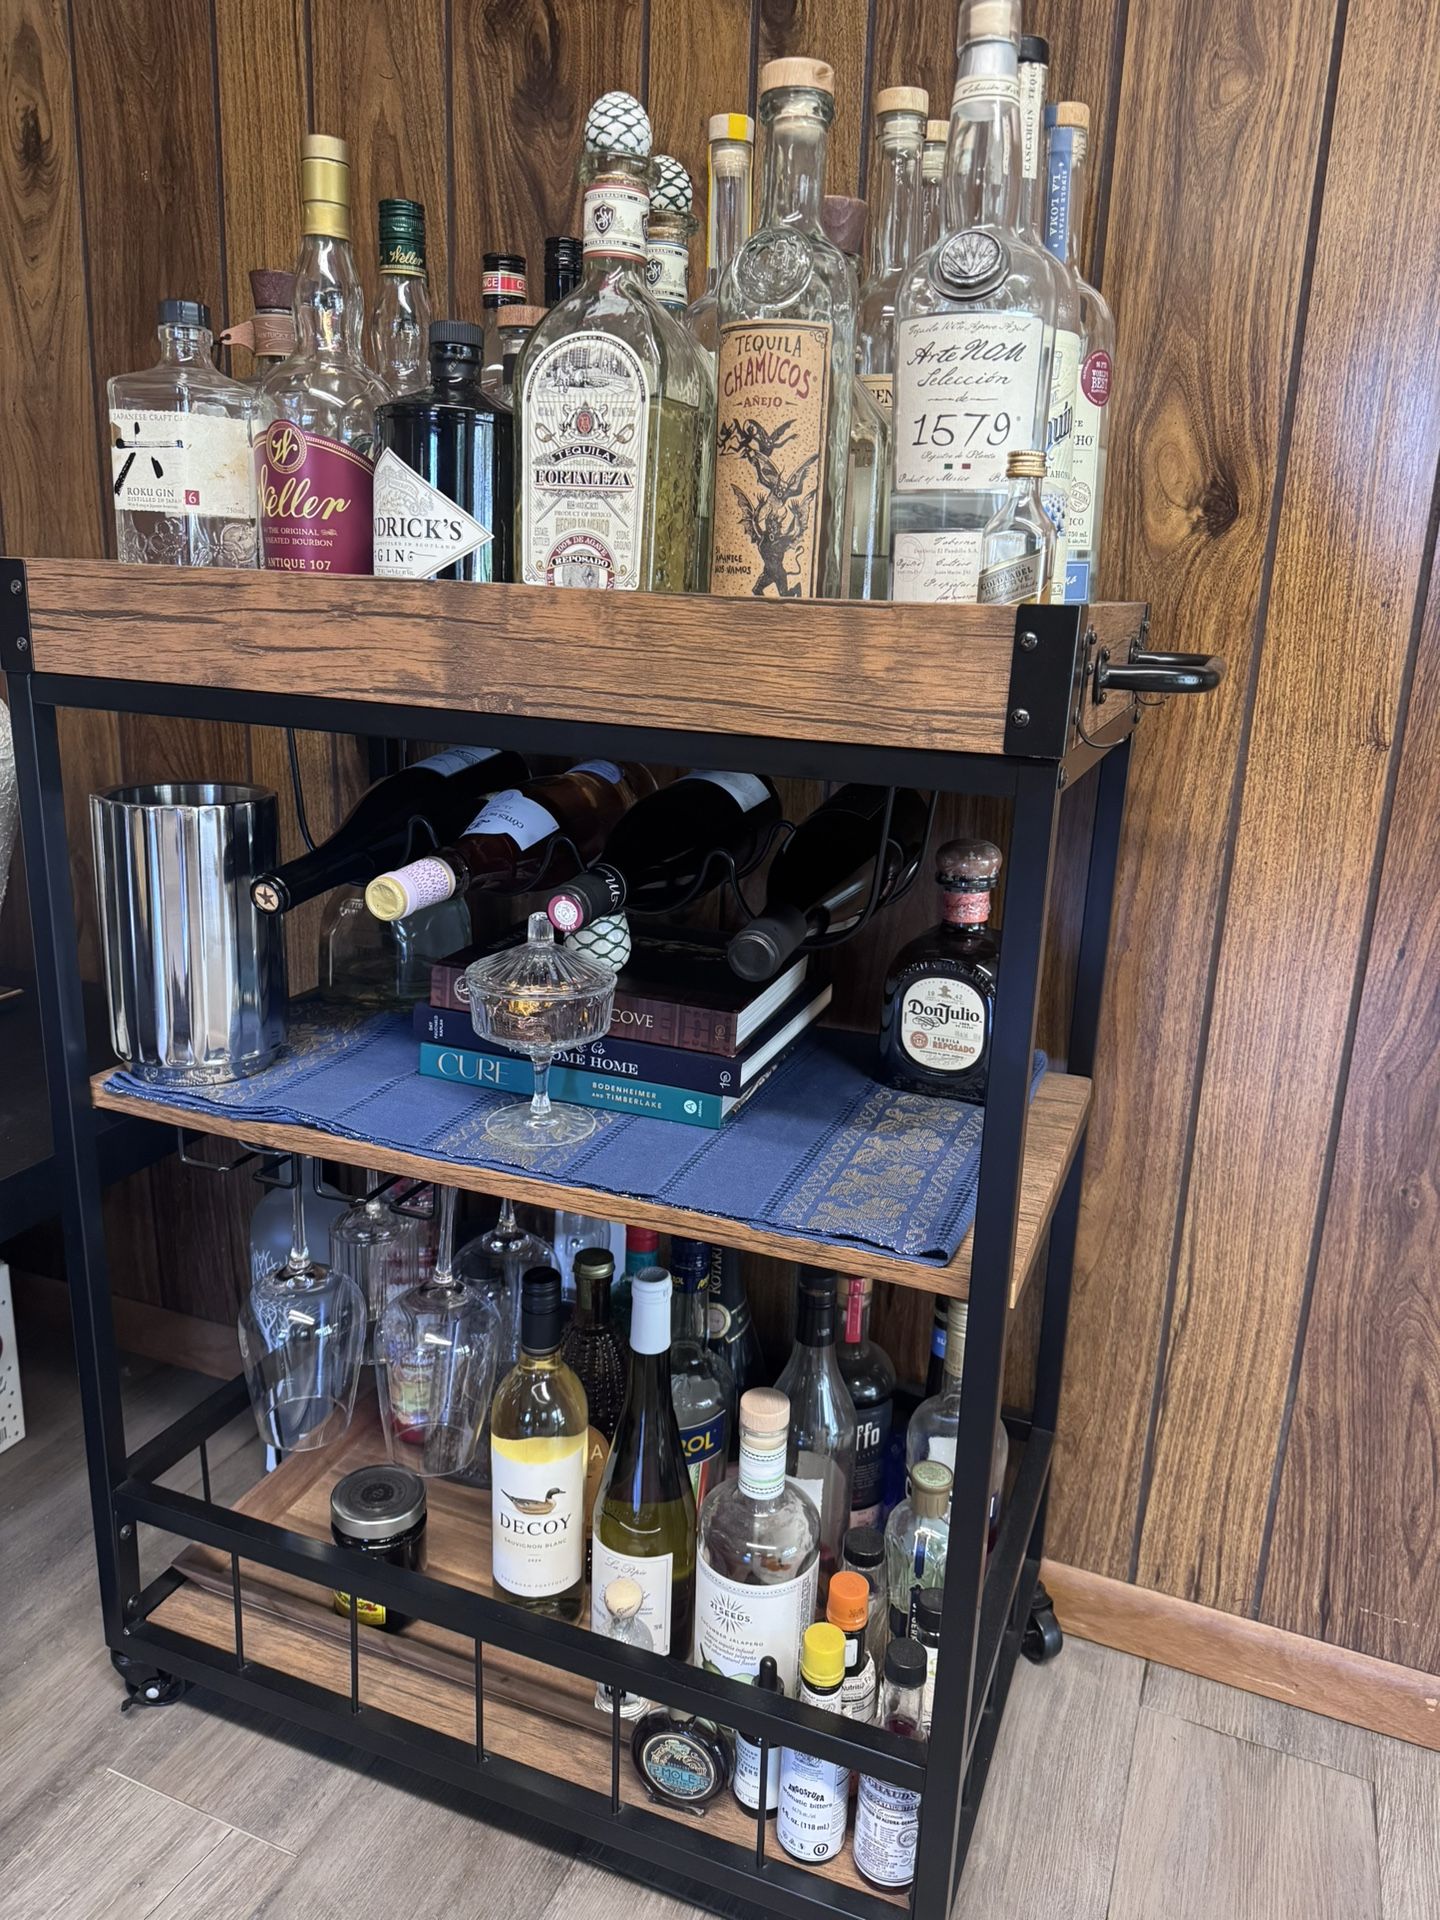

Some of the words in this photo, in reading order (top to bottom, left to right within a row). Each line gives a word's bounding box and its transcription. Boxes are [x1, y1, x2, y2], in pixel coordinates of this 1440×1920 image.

[1052, 174, 1061, 194] LA
[1049, 198, 1060, 237] LOMA
[735, 334, 802, 358] TEQUILA
[724, 351, 812, 400] CHAMUCOS
[917, 366, 1012, 388] Selección
[743, 395, 783, 408] AÑEJO
[113, 412, 147, 422] JAPANESE
[149, 413, 173, 422] CRAFT
[912, 411, 1012, 448] 1579
[555, 445, 611, 460] TEQUILA
[535, 469, 634, 487] FORTALEZA
[127, 487, 154, 497] ROKU
[155, 488, 175, 497] GIN
[188, 491, 197, 504] 6
[280, 527, 320, 536] ORIGINAL
[292, 538, 333, 548] BOURBON
[267, 558, 306, 570] ANTIQUE
[310, 560, 332, 571] 107
[377, 549, 405, 563] GIN
[555, 556, 610, 569] REPOSADO
[932, 1041, 976, 1054] REPOSADO
[933, 1036, 960, 1044] TEQUILA
[438, 1052, 511, 1086] CURE
[590, 1056, 639, 1076] HOME
[592, 1081, 657, 1099] BODENHEIMER
[604, 1093, 663, 1110] TIMBERLAKE
[590, 1444, 603, 1461] A
[500, 1511, 571, 1537] DECOY
[504, 1536, 543, 1550] SAUVIGNON
[544, 1537, 567, 1549] BLANC
[709, 1599, 718, 1611] 21
[719, 1606, 753, 1624] SEEDS
[661, 1766, 696, 1785] MOLE
[787, 1783, 825, 1803] ANGOSTURA
